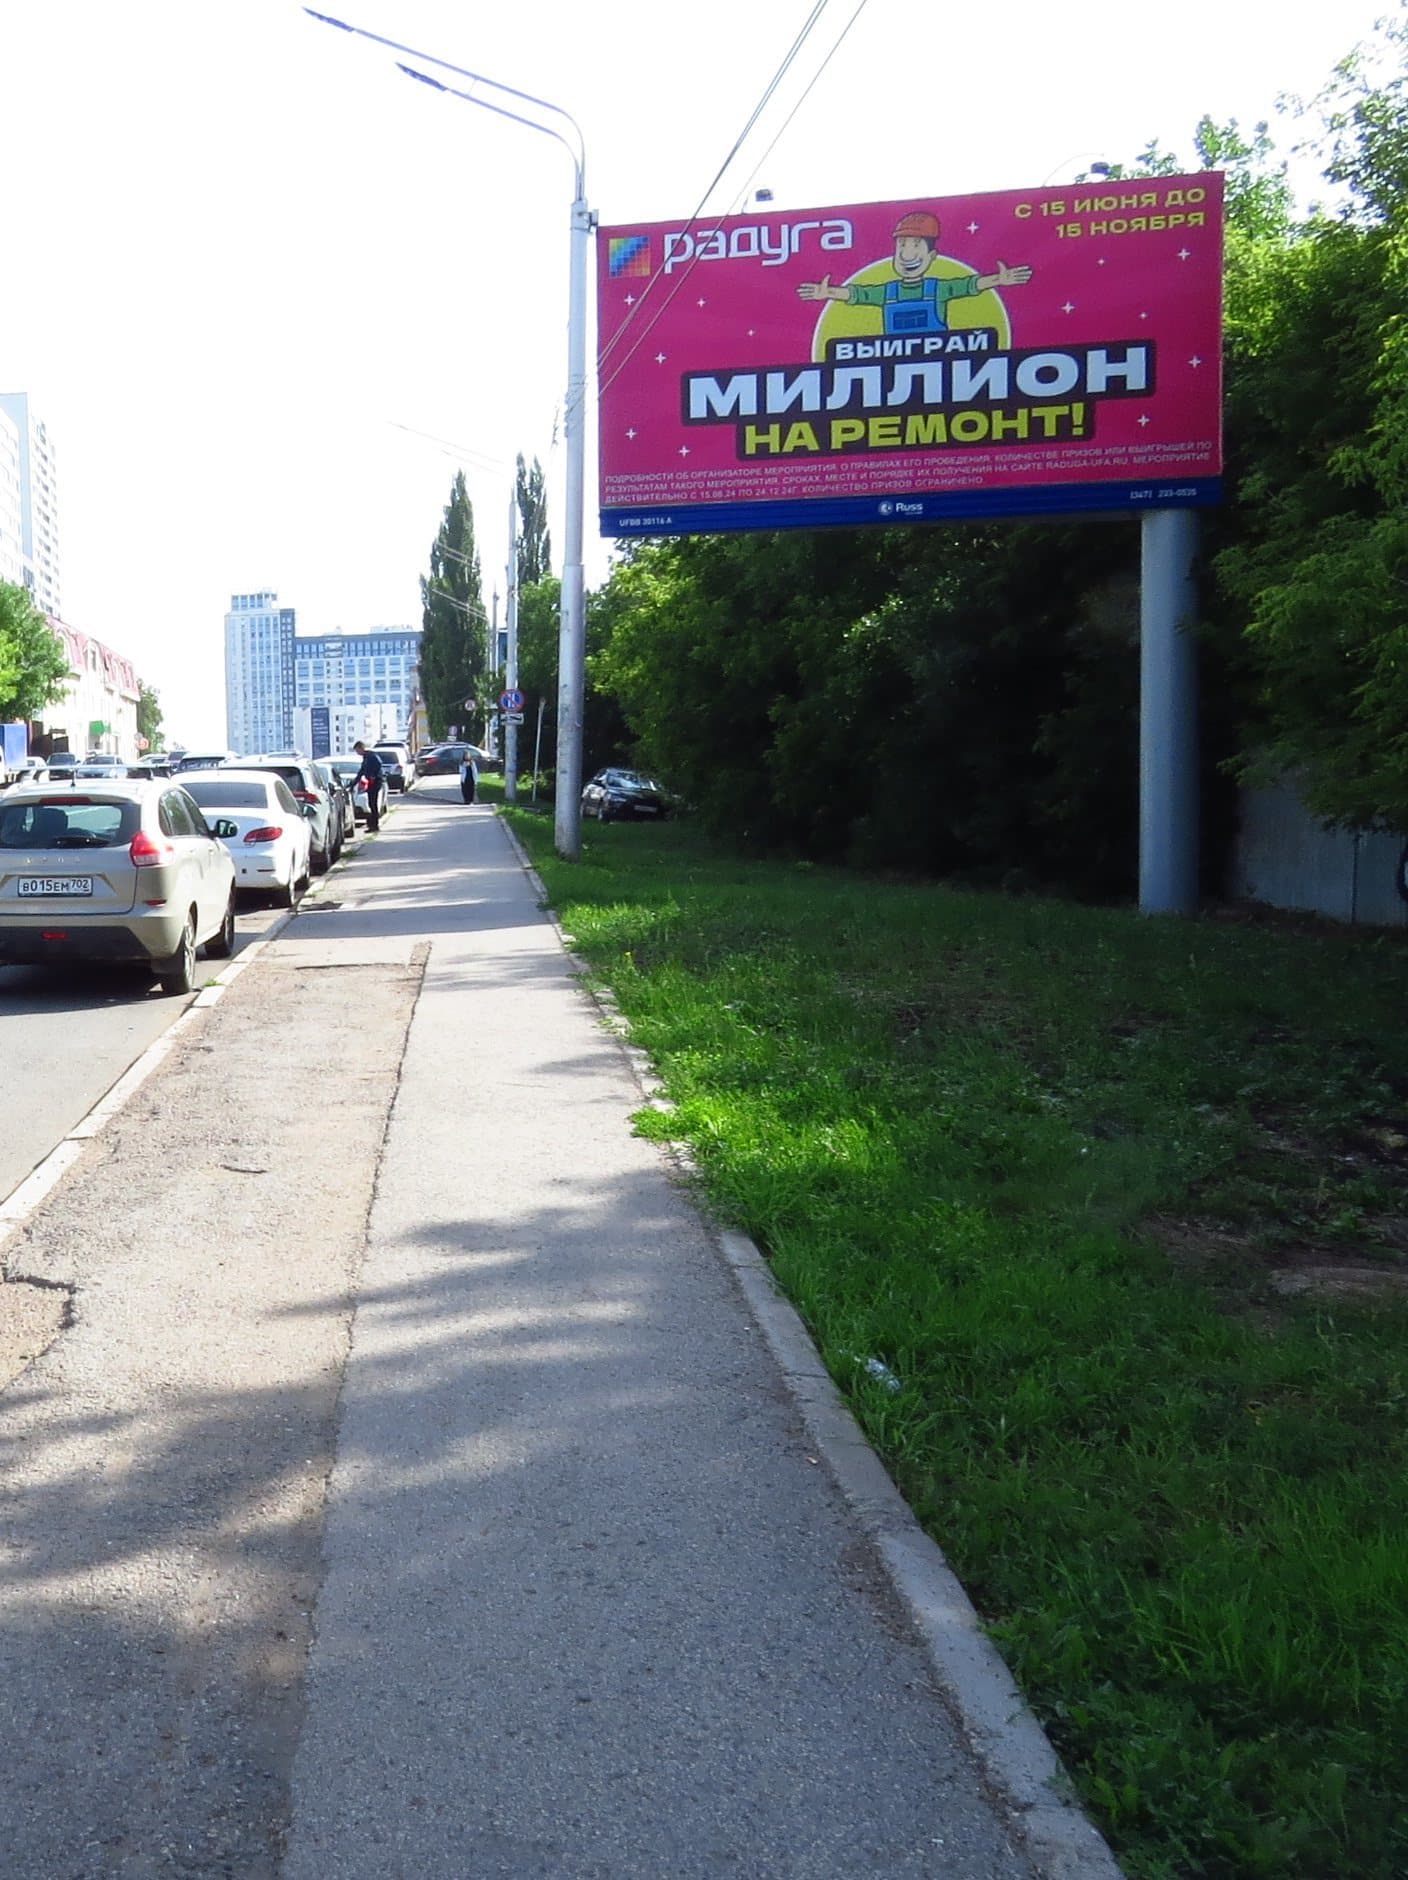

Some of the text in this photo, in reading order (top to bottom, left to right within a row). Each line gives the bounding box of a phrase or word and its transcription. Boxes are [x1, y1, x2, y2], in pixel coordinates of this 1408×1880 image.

[1015, 188, 1206, 218] С 15 ИЮНЯ ДО
[1056, 212, 1205, 238] 15 НОЯБРЯ
[664, 219, 853, 274] радуга
[835, 331, 988, 360] ВЫИГРАЙ
[689, 347, 1147, 418] МИЛЛИОН
[744, 403, 1085, 455] НА РЕМОНТ!
[604, 471, 673, 484] ПОДРОБНОСТИ
[674, 470, 688, 480] ОБ
[690, 466, 761, 479] ОРГАНИЗАТОРЕ
[840, 461, 848, 470] О
[850, 458, 900, 470] ПРАВИЛАХ
[903, 457, 921, 467] ЕГО
[1196, 440, 1212, 450] ПО
[604, 482, 667, 494] РЕЗУЛЬТАТАМ
[670, 480, 704, 490] ТАКОГО
[824, 471, 857, 481] МЕСТЕ
[859, 470, 867, 479] И
[869, 468, 913, 479] ПОРЯДКЕ
[917, 467, 930, 476] ИХ
[994, 462, 1008, 472] НА
[1010, 460, 1043, 471] САЙТЕ
[604, 491, 687, 504] ДЕЙСТВИТЕЛЬНО
[689, 491, 697, 499] С
[738, 487, 752, 497] ПО
[802, 481, 868, 493] КОЛИЧЕСТВО
[871, 478, 912, 489] ПРИЗОВ
[895, 501, 923, 512] Russ
